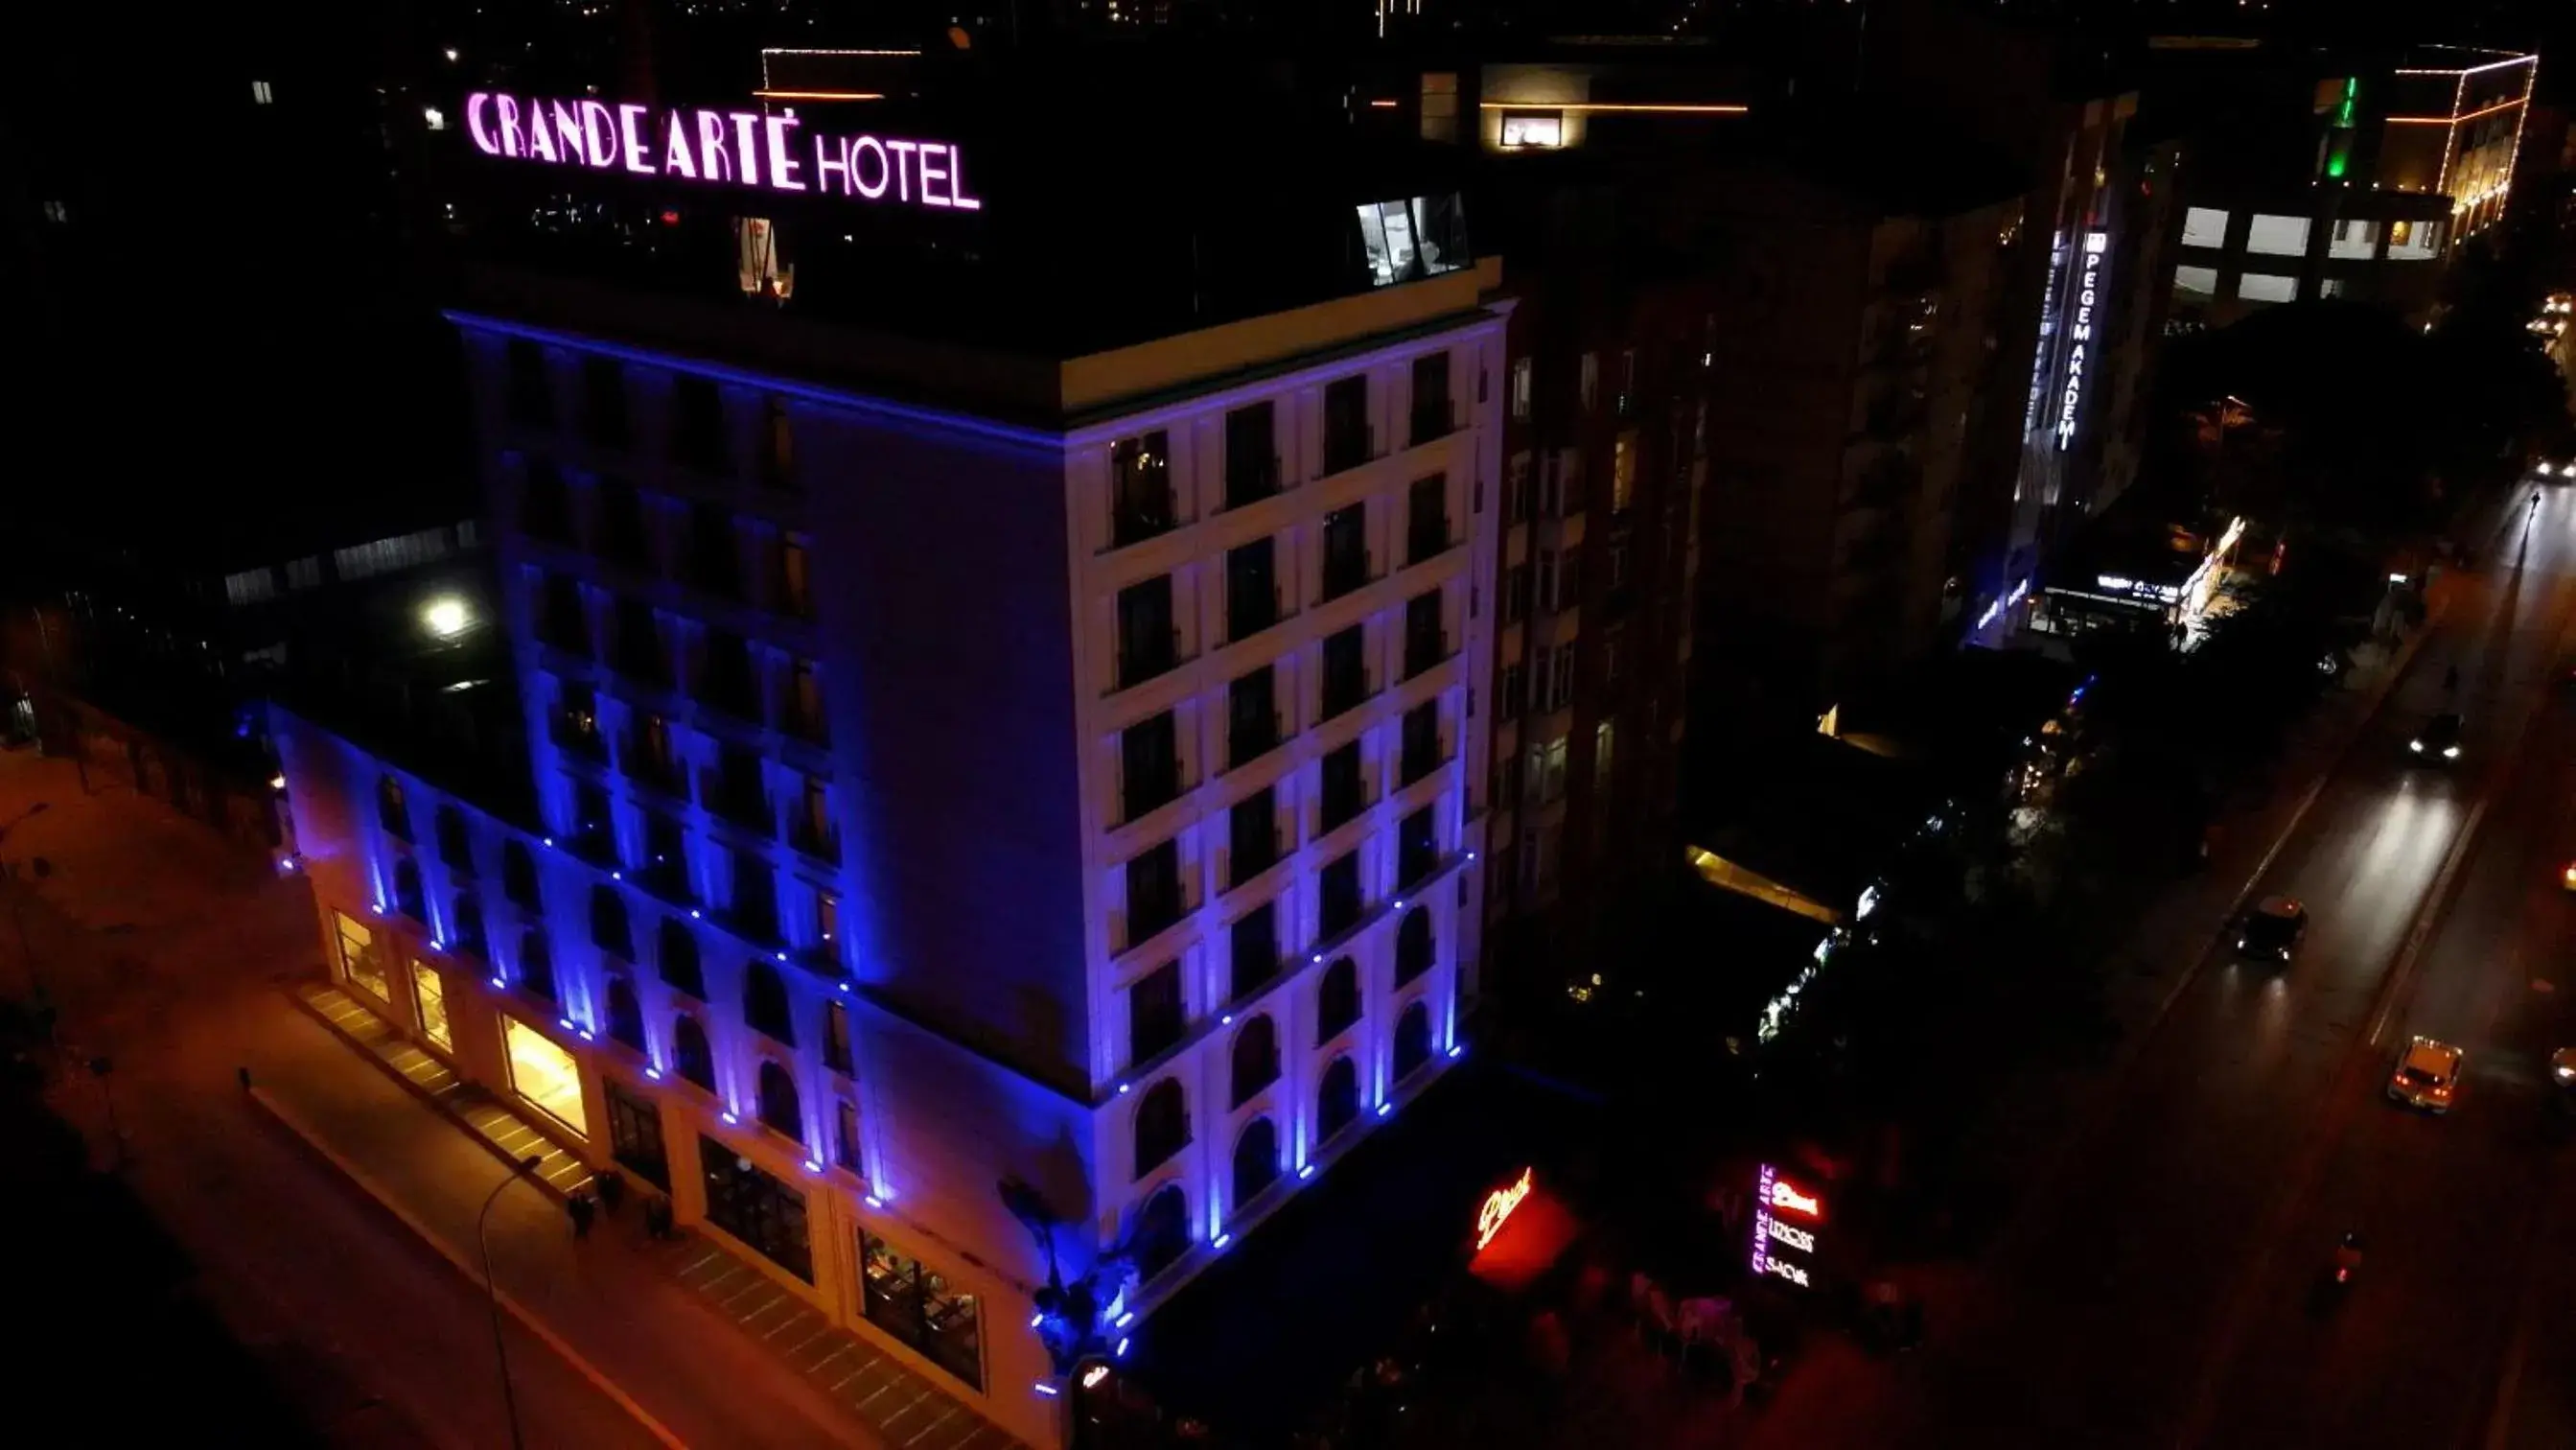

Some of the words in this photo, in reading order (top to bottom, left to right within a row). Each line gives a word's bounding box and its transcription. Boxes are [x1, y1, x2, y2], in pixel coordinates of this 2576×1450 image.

[467, 92, 657, 175] GRANDE
[815, 134, 981, 210] HOTEL
[2074, 253, 2100, 341] PEGEM
